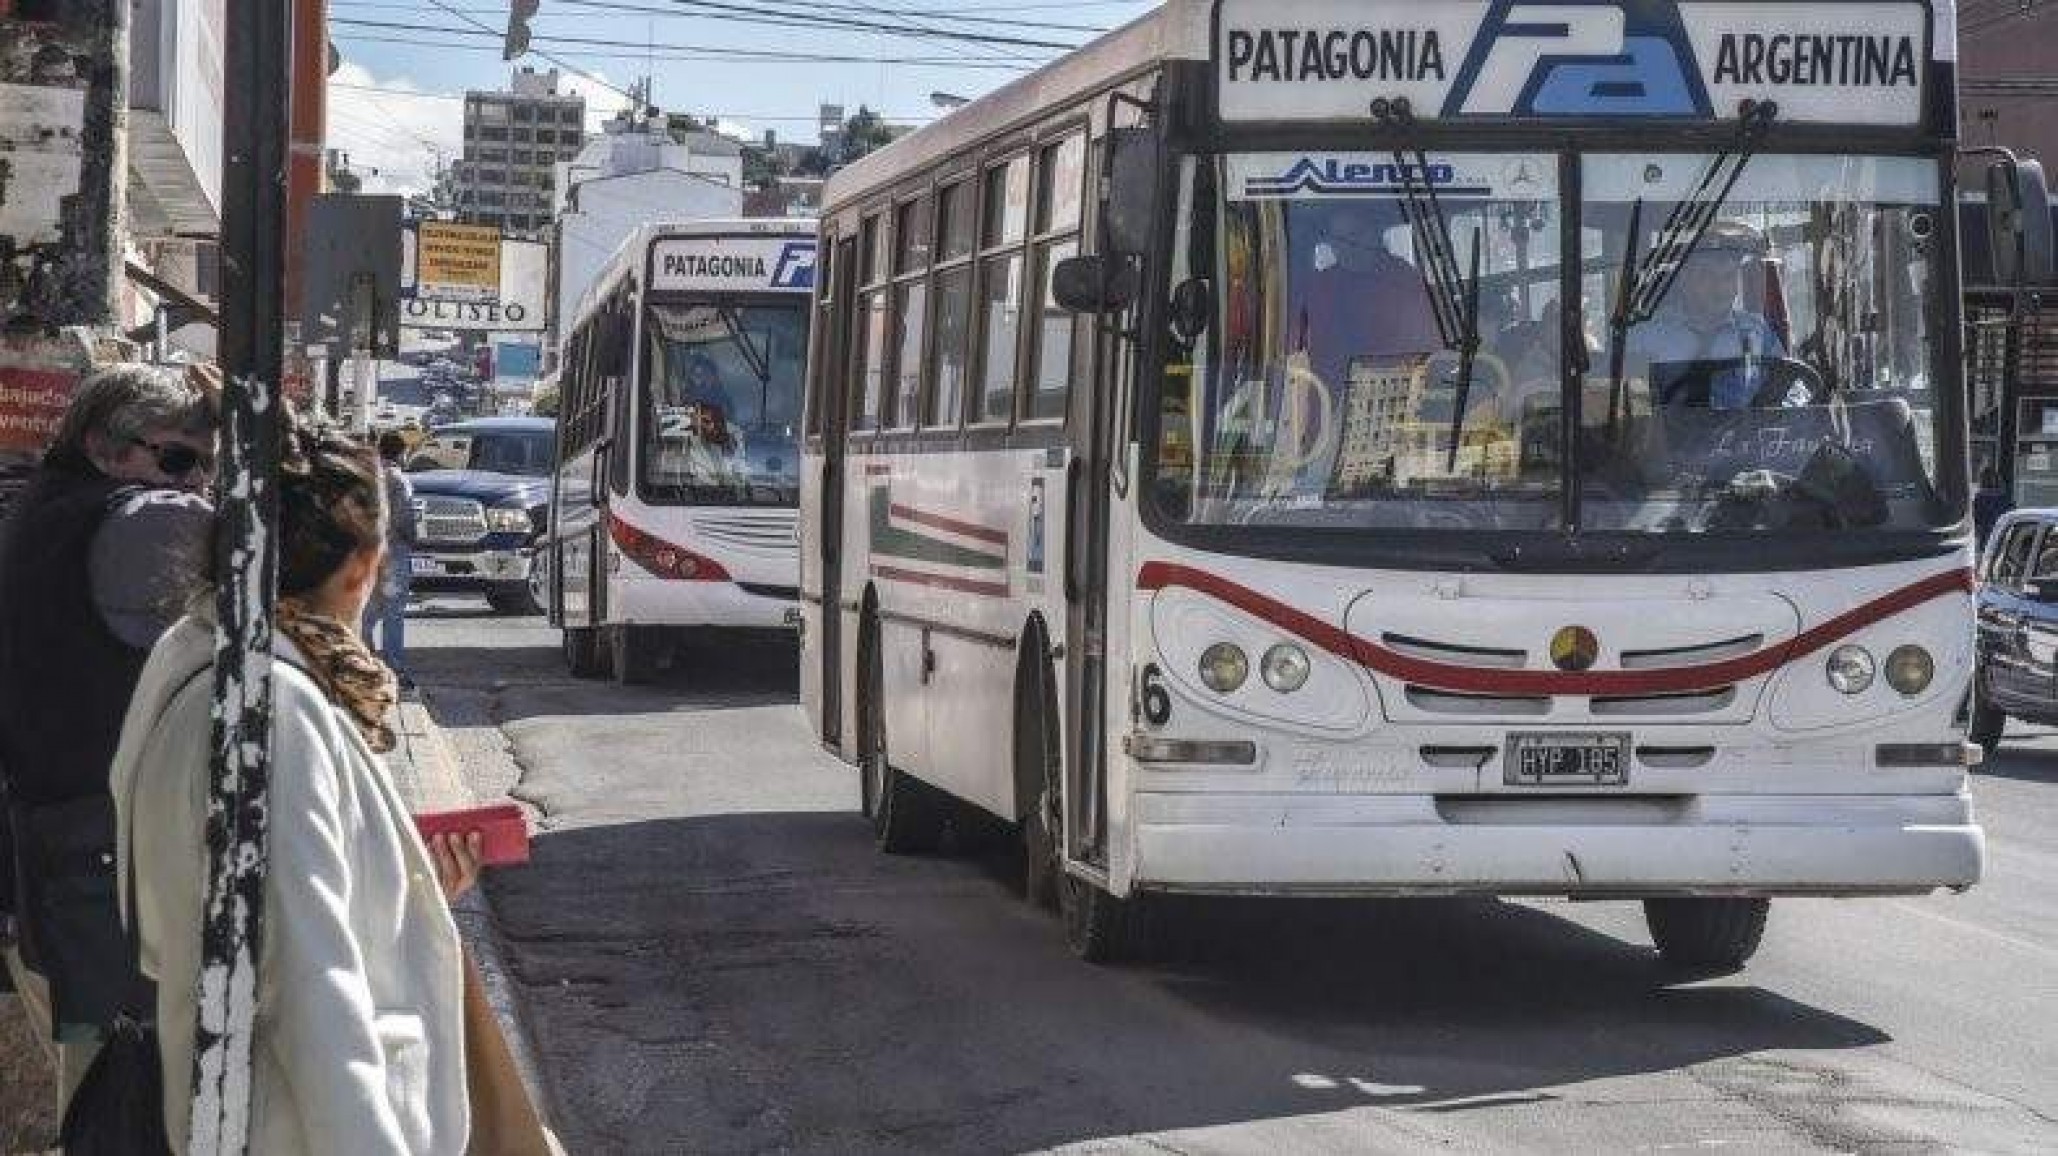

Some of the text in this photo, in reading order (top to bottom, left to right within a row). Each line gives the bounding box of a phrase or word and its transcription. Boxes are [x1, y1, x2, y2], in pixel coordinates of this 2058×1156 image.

[1229, 30, 1445, 82] PATAGONIA
[1713, 33, 1917, 86] ARGENTINA
[663, 255, 768, 278] PATAGONIA
[408, 299, 525, 322] OLISEO
